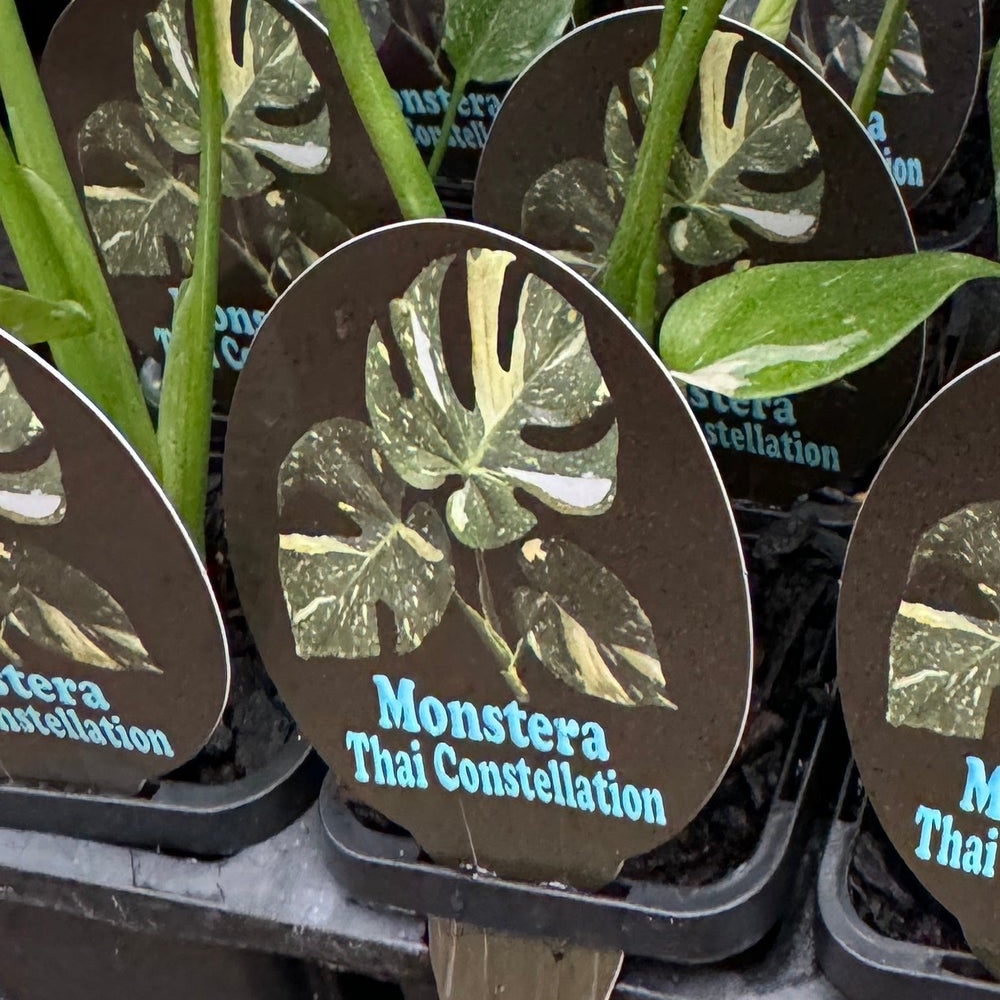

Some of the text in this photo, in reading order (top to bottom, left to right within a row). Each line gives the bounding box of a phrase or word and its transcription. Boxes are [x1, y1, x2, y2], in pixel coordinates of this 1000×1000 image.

[372, 674, 610, 762] Monstera
[345, 730, 667, 826] Thai Constellation
[914, 804, 999, 879] Thai
